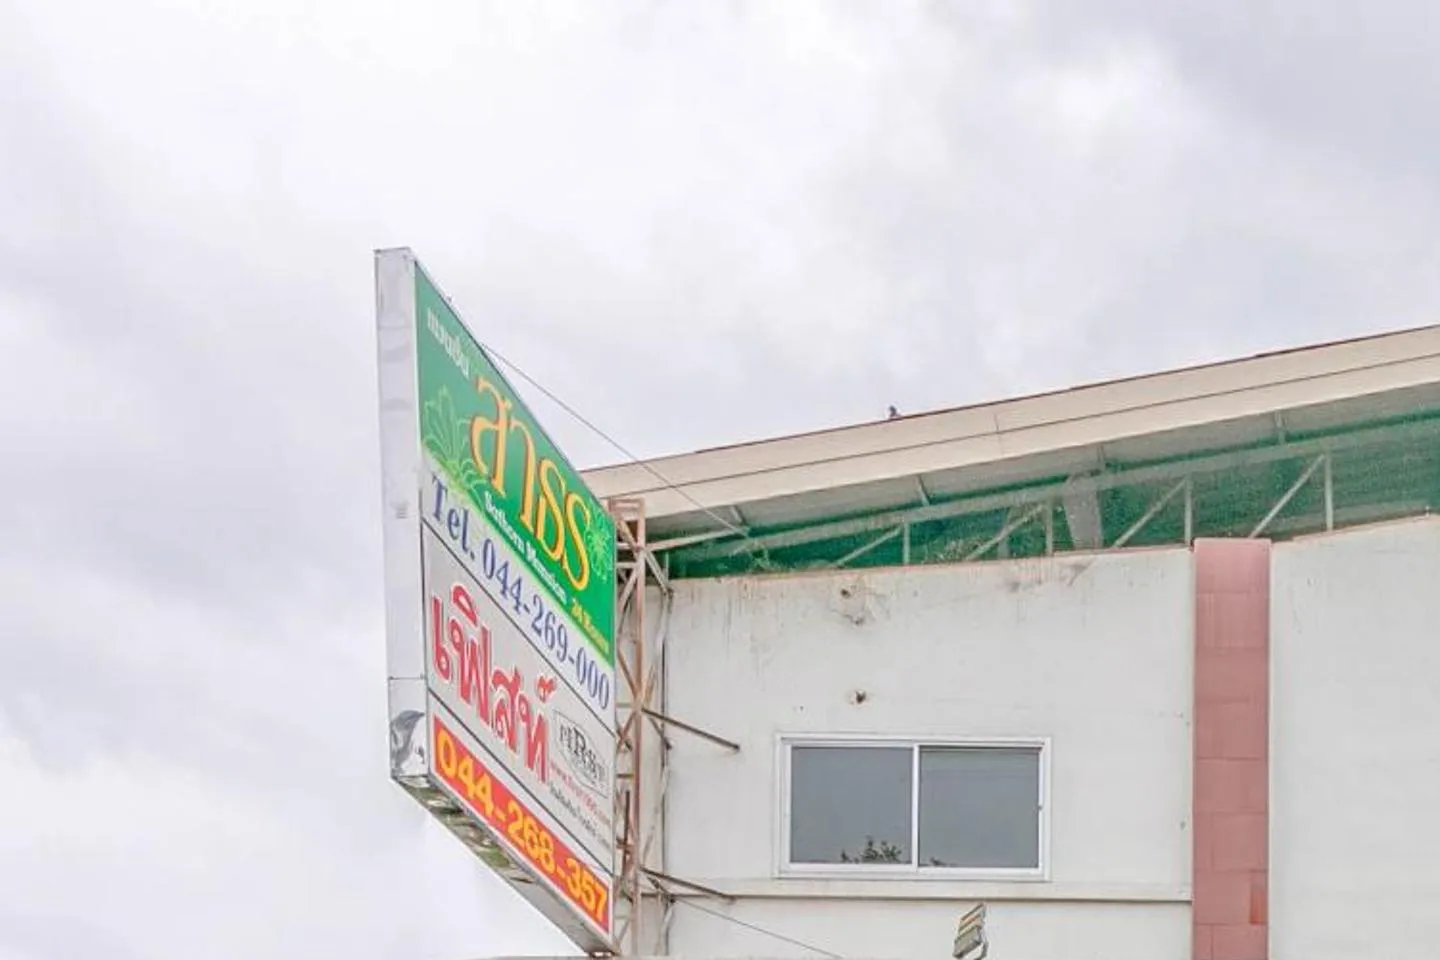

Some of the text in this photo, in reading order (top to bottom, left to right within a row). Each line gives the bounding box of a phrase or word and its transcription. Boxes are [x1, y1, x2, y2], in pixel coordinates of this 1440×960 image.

[431, 473, 475, 561] Tel.
[482, 537, 610, 712] 044-269-000
[431, 585, 557, 784] เฟิสท์
[435, 729, 609, 922] 044-268-357
